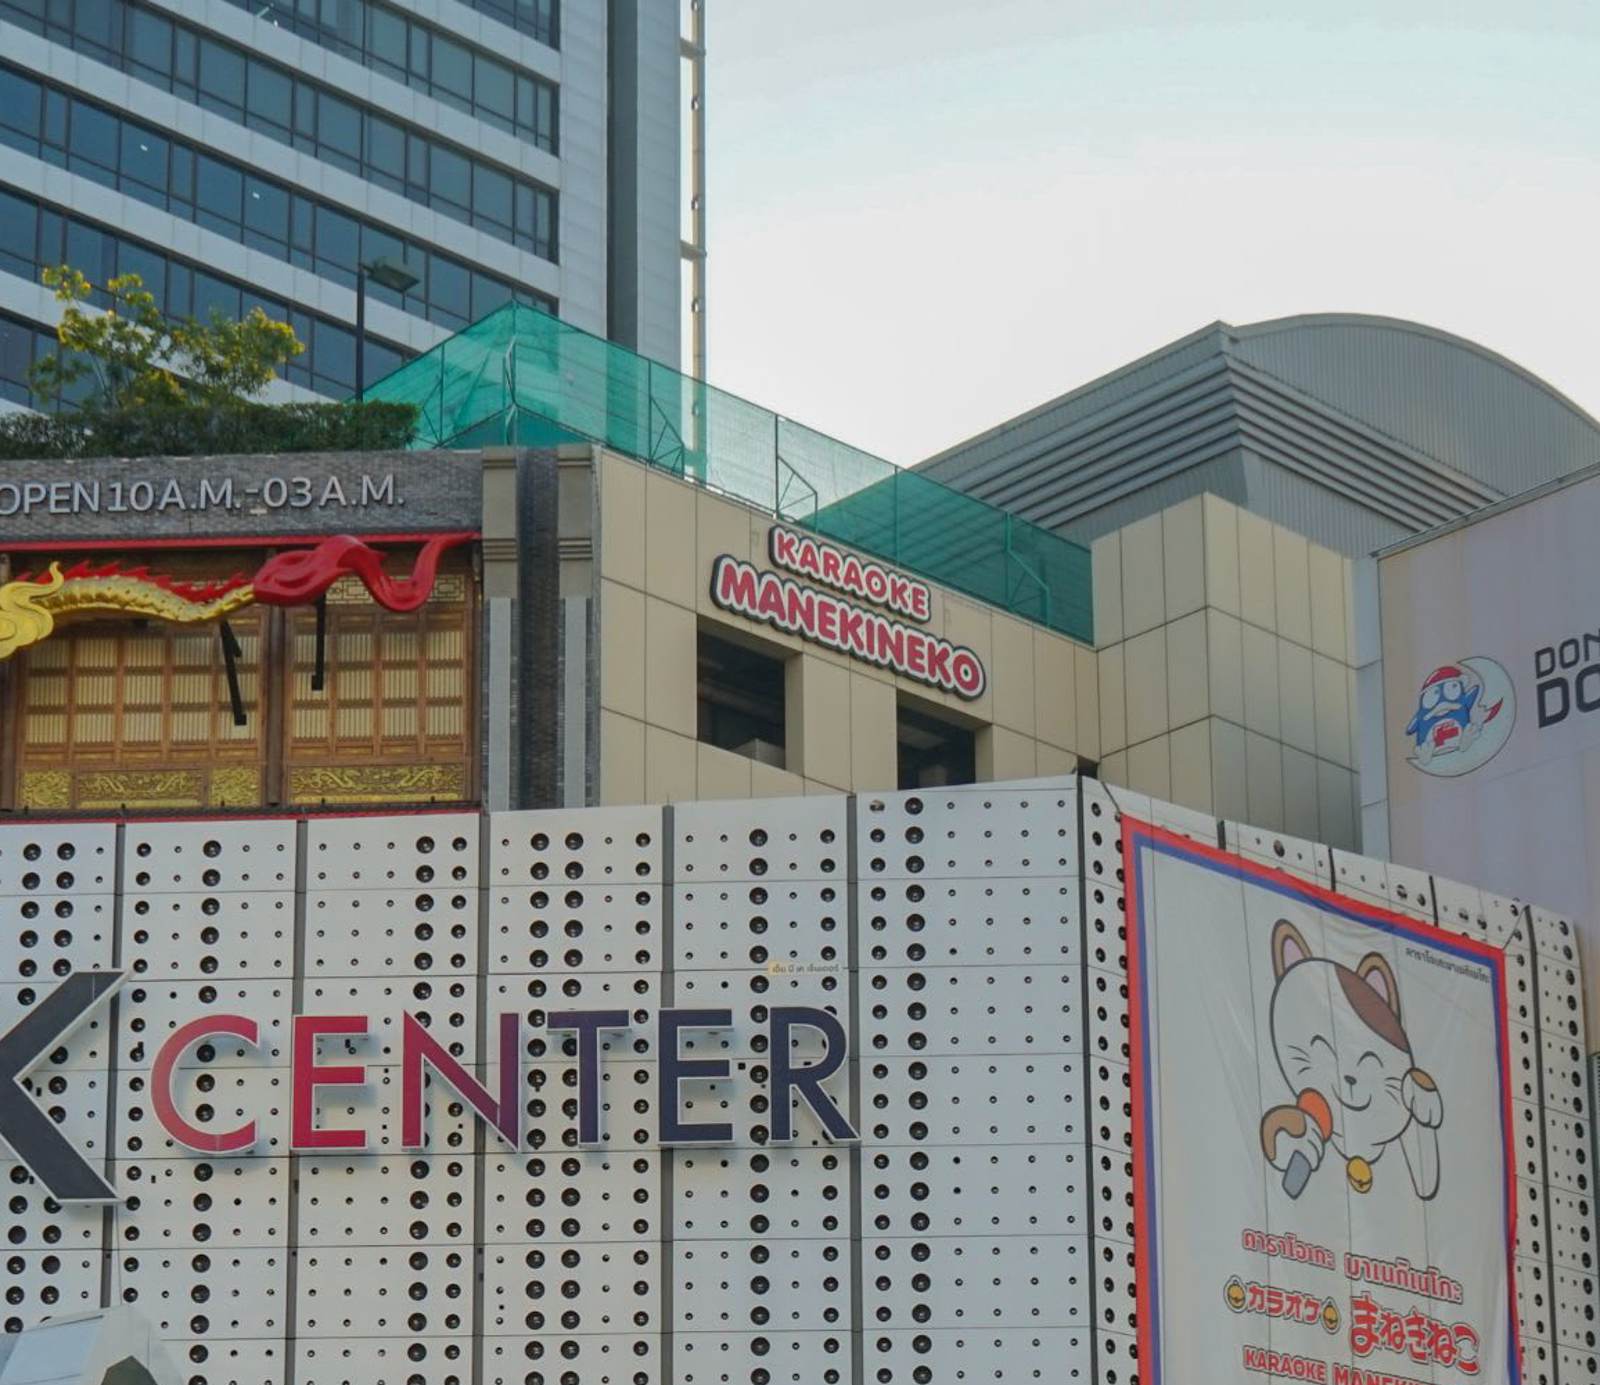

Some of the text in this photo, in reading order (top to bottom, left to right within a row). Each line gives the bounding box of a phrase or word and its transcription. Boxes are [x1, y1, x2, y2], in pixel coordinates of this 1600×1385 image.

[0, 481, 100, 516] OPEN
[771, 527, 930, 621] KARAOKE
[713, 556, 984, 699] MANEKINEKO
[150, 1005, 862, 1154] CENTER
[1243, 1347, 1327, 1385] KARAOKE
